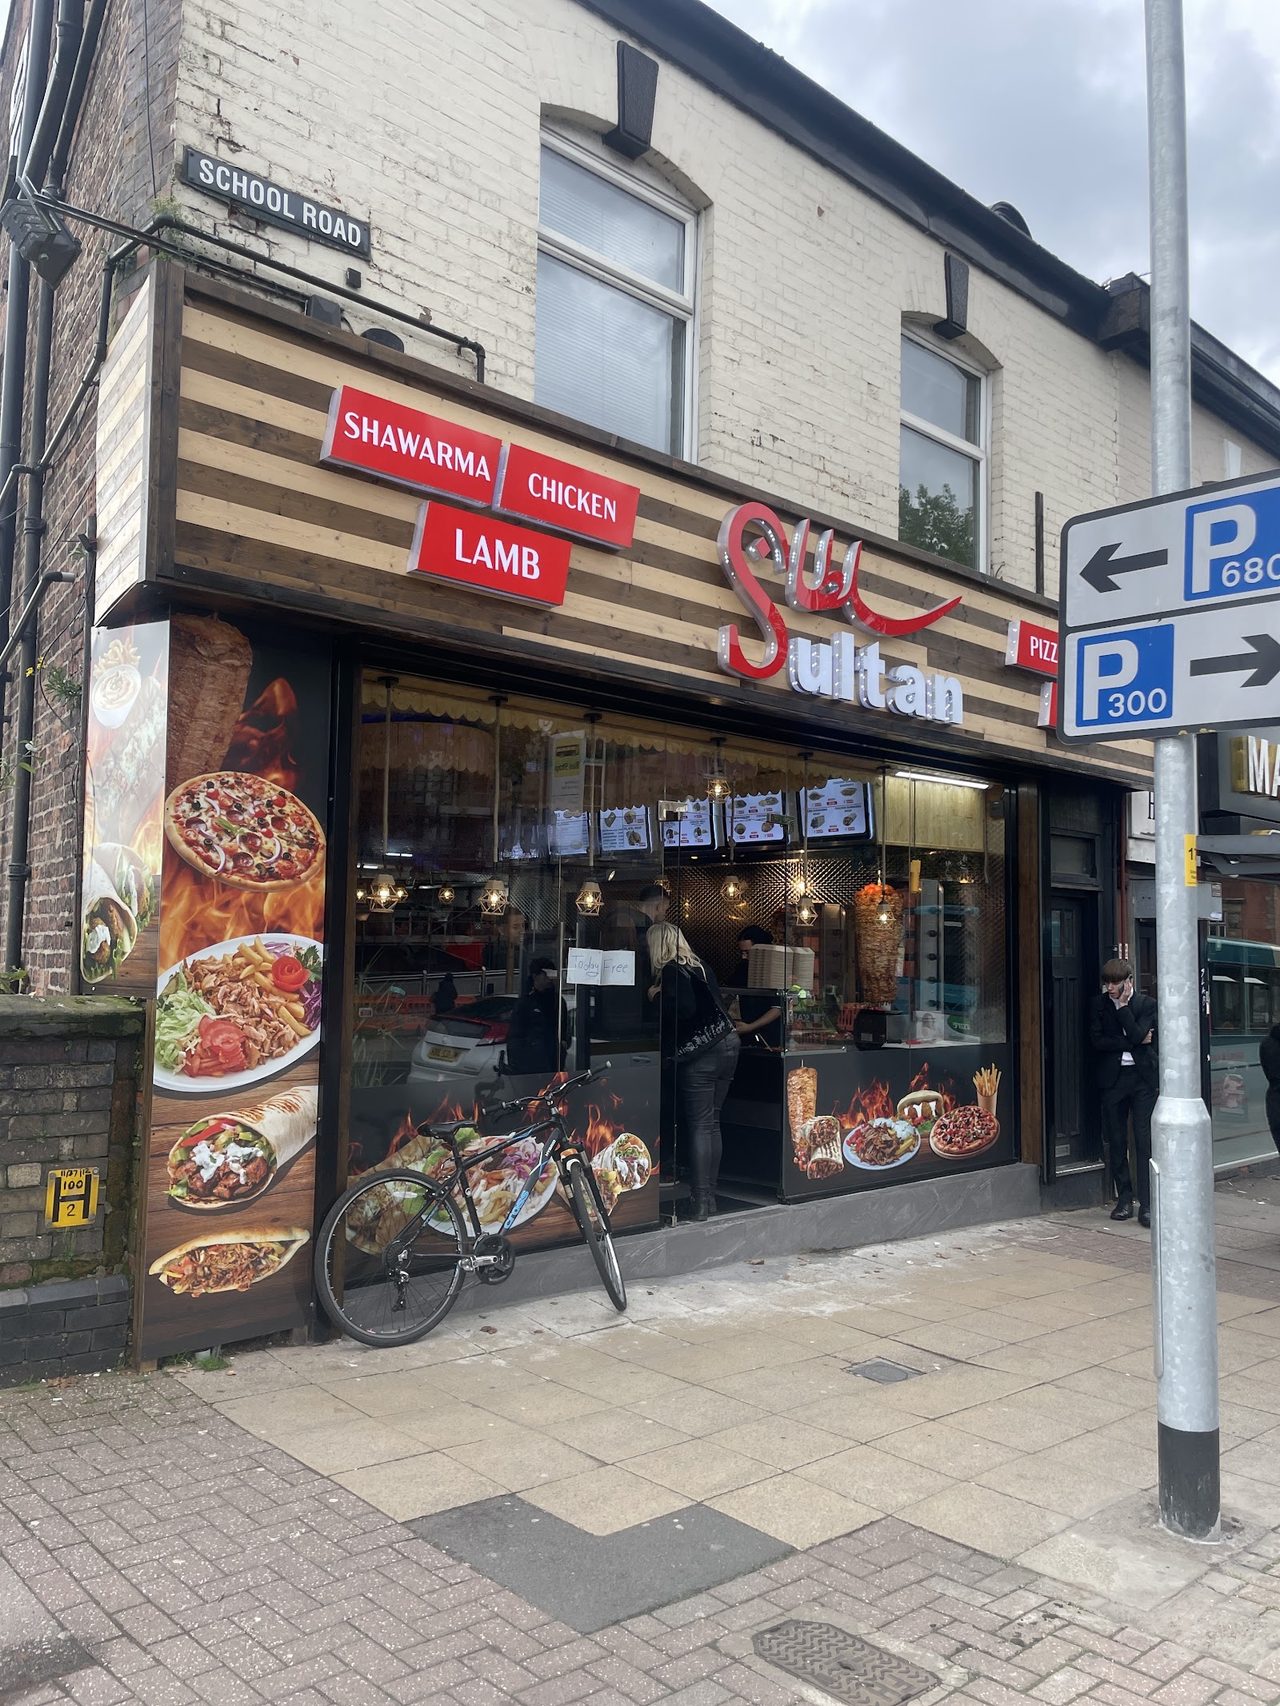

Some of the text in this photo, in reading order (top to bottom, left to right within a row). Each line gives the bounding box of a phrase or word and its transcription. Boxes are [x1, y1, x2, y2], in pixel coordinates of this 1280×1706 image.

[199, 158, 362, 248] SCHOOL ROAD
[343, 411, 492, 482] SHAWARMA
[527, 472, 618, 524] CHICKEN
[454, 527, 541, 581] LAMB
[1191, 503, 1257, 594] P
[1082, 639, 1139, 721] P
[1107, 687, 1168, 718] 300
[603, 959, 628, 974] Free
[51, 1173, 92, 1223] H
[63, 1180, 84, 1190] 100
[66, 1203, 76, 1217] 2
